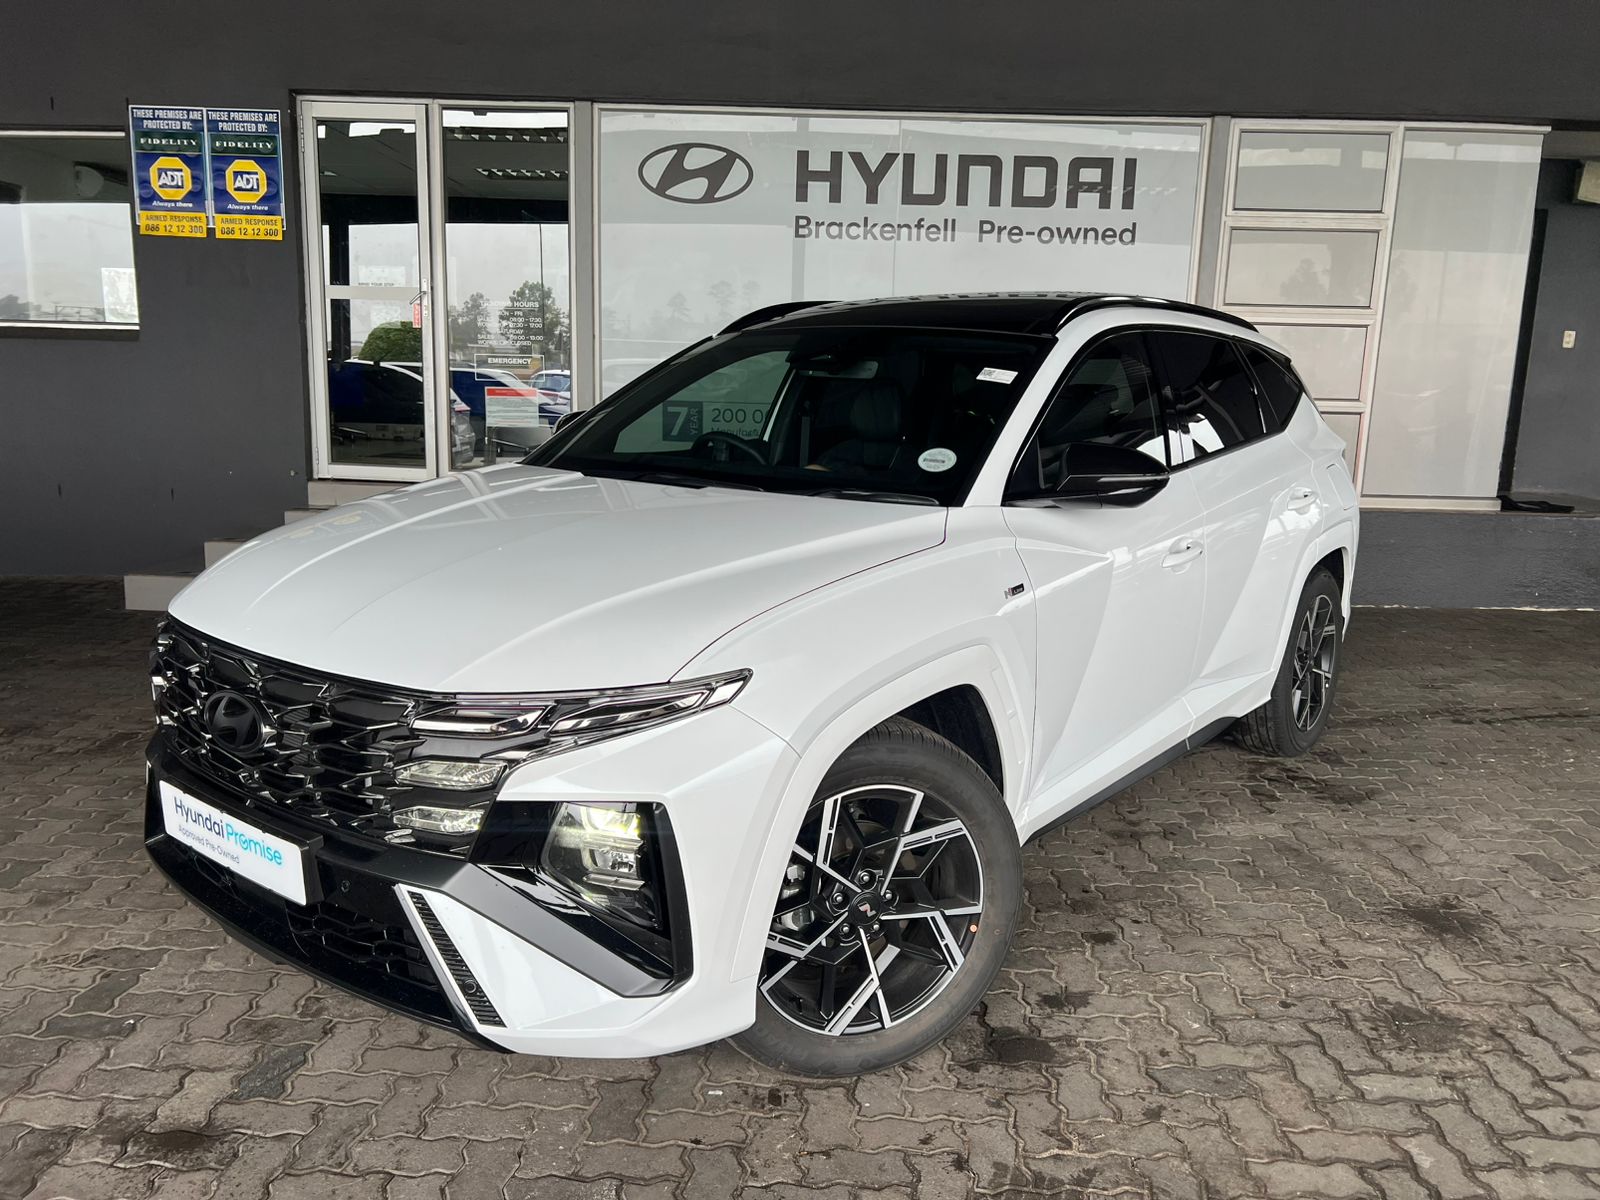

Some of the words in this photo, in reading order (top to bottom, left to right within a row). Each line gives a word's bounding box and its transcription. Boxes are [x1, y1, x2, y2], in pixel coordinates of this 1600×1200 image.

[132, 109, 154, 118] THESE
[154, 110, 188, 119] PREMISES
[189, 111, 203, 120] ARE
[208, 111, 229, 121] THESE
[229, 112, 263, 122] PREMISES
[264, 113, 278, 122] ARE
[143, 120, 181, 129] PROTECTED
[218, 122, 257, 132] PROTECTED
[257, 123, 268, 132] BY:
[215, 141, 273, 149] FIDELITY
[158, 171, 184, 186] ADT
[234, 174, 259, 189] ADT
[795, 150, 1138, 210] HYUNDAI
[227, 203, 250, 211] Always
[245, 218, 278, 226] RESPONSE
[176, 225, 186, 233] 12
[188, 225, 204, 234] 300
[239, 227, 249, 236] 12
[252, 228, 261, 236] 12
[264, 229, 279, 237] 300
[794, 215, 957, 242] Brackenfell
[978, 219, 1137, 246] Pre-owned
[487, 357, 532, 365] EMERGENCY
[667, 406, 688, 436] 7
[711, 408, 746, 423] 200
[752, 408, 767, 424] 0
[689, 408, 699, 436] YEAR
[174, 797, 225, 838] Hyundai
[226, 823, 283, 866] Promise
